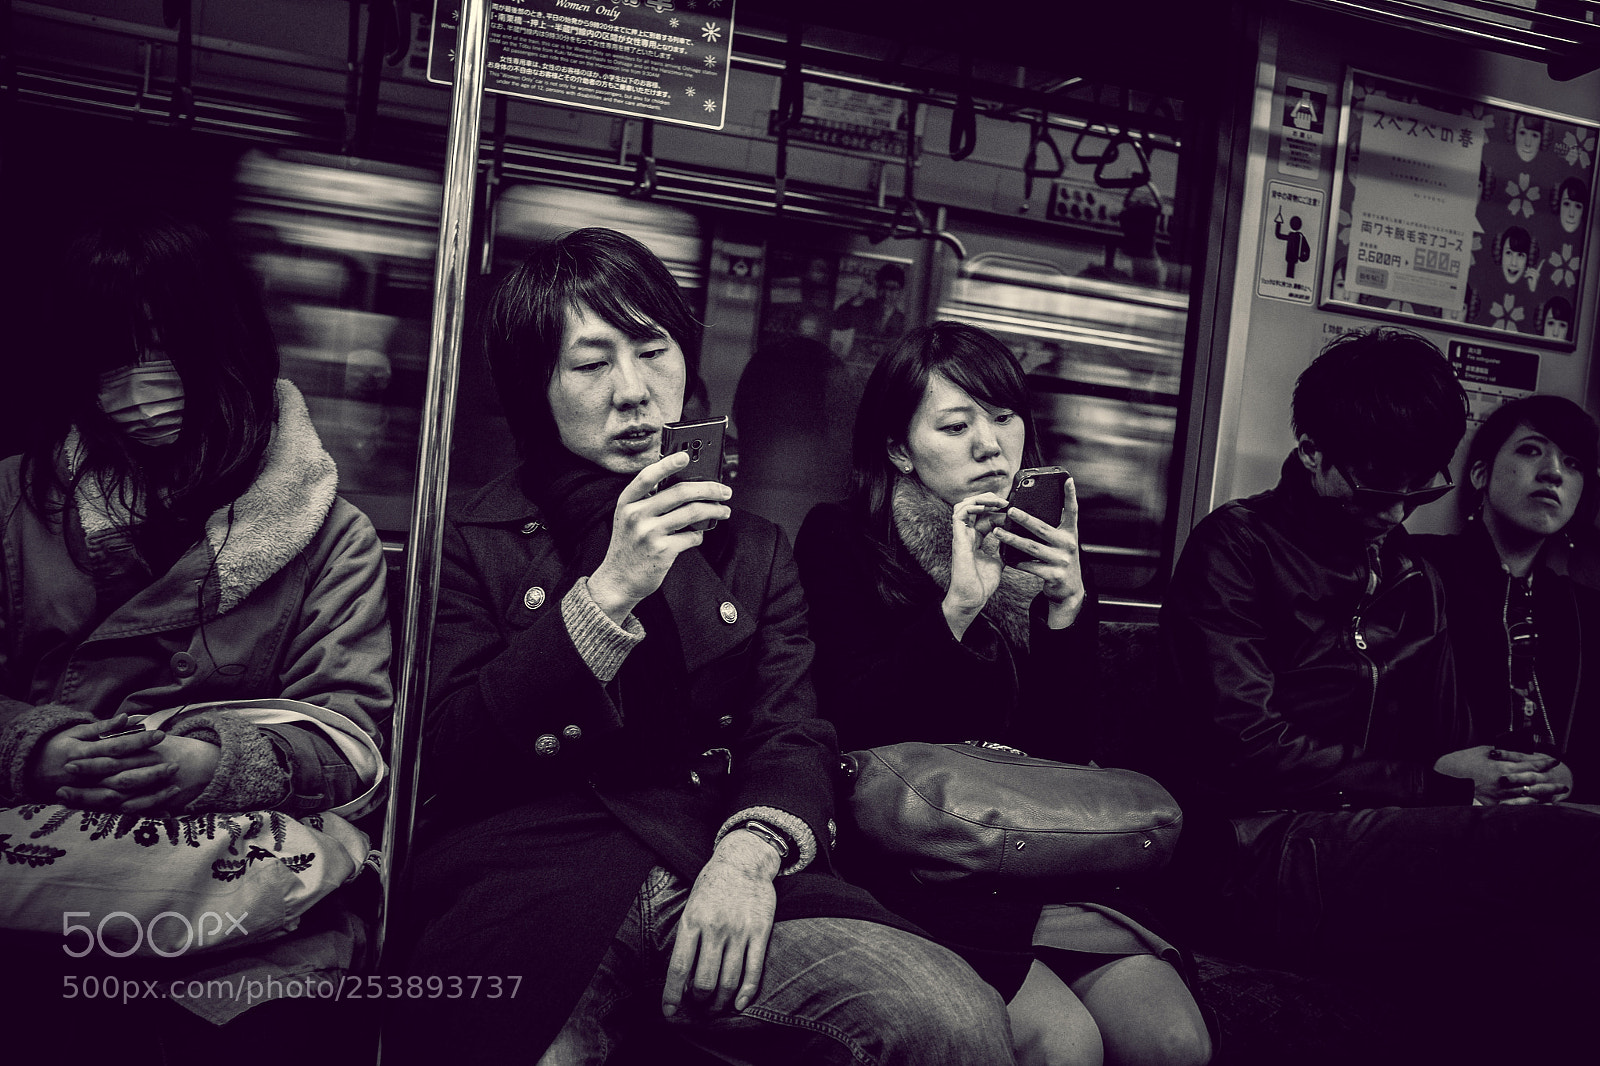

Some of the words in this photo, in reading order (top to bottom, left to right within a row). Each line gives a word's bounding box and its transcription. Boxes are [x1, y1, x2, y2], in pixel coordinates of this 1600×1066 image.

[555, 0, 590, 12] Women
[594, 4, 621, 22] Only
[511, 47, 538, 57] passengers
[1372, 109, 1472, 147] スベスベの春
[1360, 220, 1463, 252] 両ワキ脱毛完了コース
